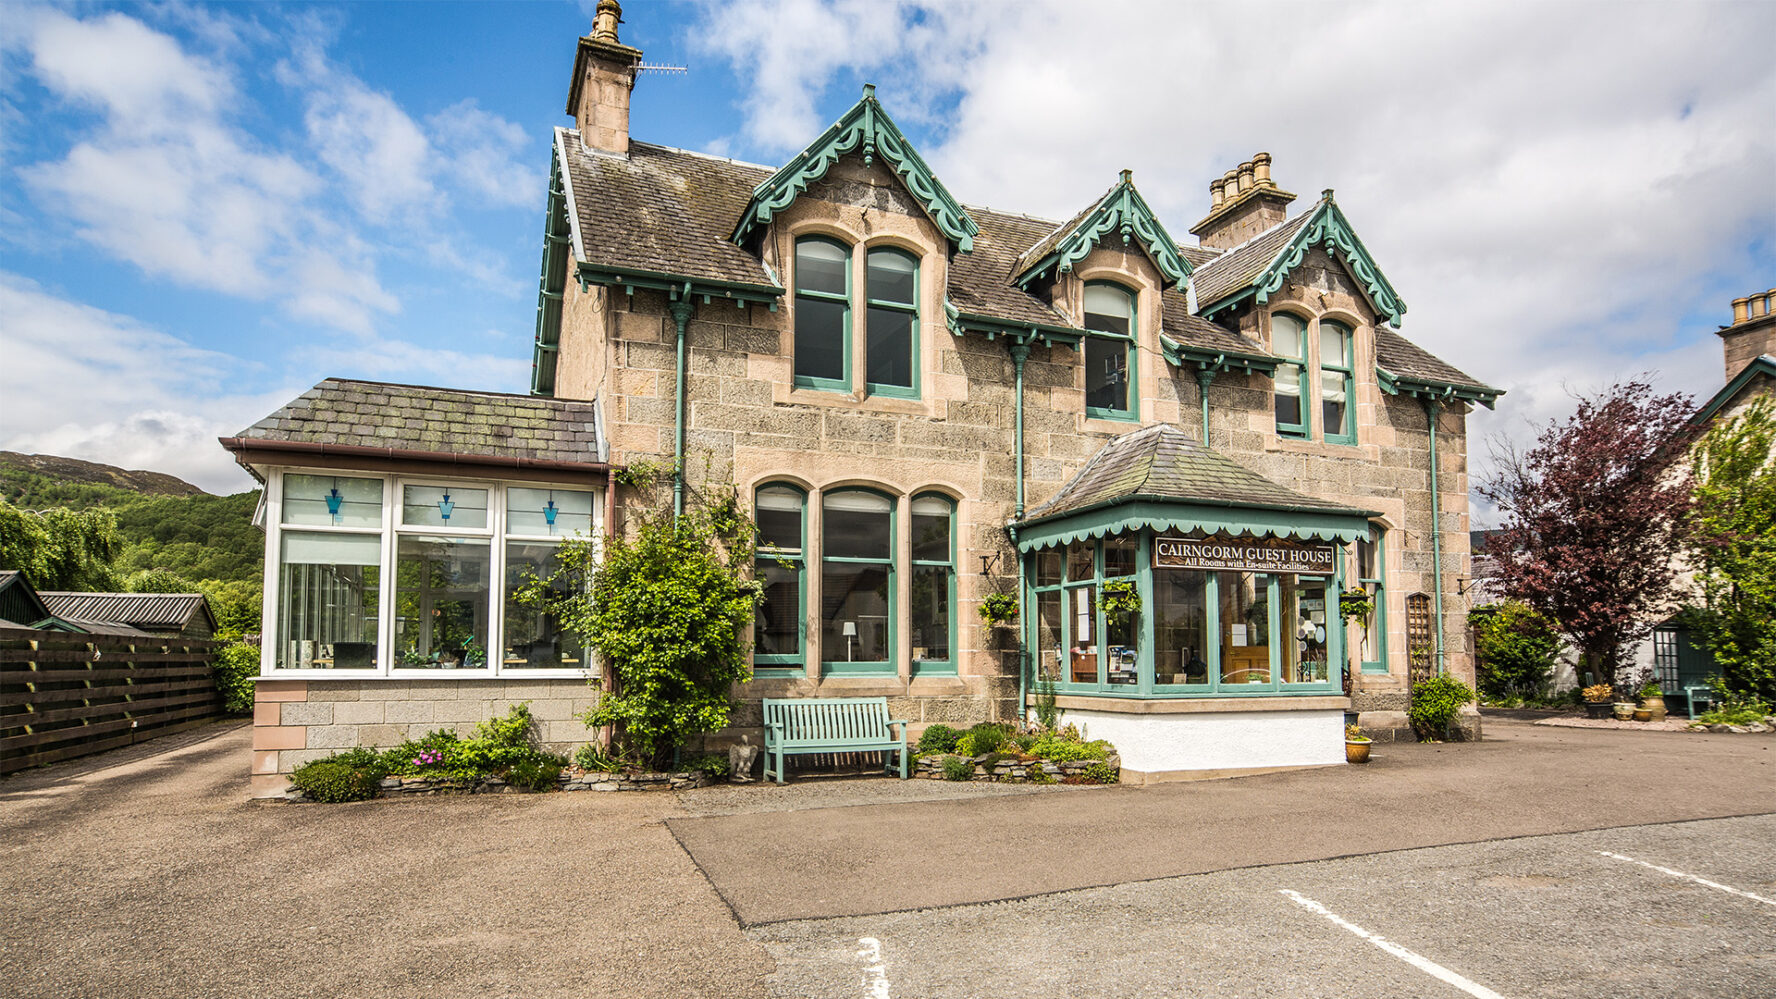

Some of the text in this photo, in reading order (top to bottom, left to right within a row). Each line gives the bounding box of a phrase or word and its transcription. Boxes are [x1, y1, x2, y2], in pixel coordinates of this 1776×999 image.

[1158, 543, 1331, 563] CAIRNGORM GUEST HOUSE
[1184, 557, 1310, 571] All Rooms with En-suite Facilities
